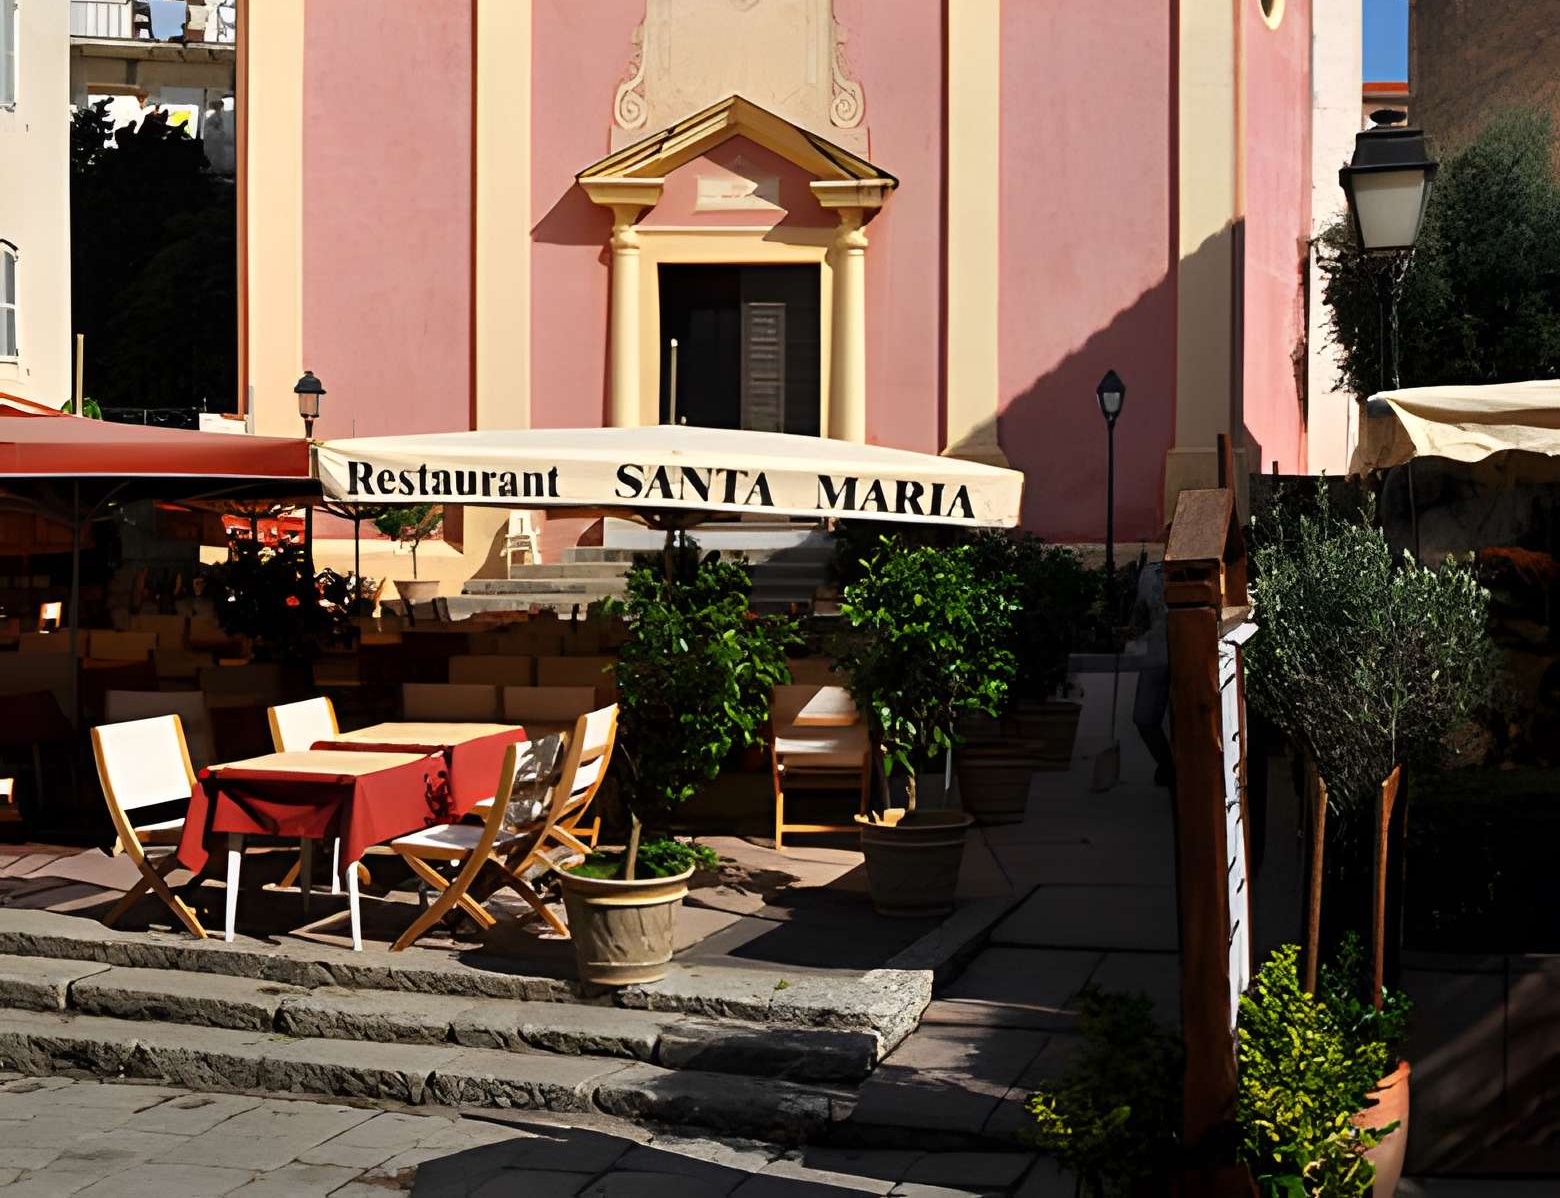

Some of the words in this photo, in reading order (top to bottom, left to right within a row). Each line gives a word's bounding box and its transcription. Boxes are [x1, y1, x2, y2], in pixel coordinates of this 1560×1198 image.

[347, 461, 560, 498] Restaurant
[615, 463, 775, 507] SANTA
[815, 474, 976, 520] MARIA
